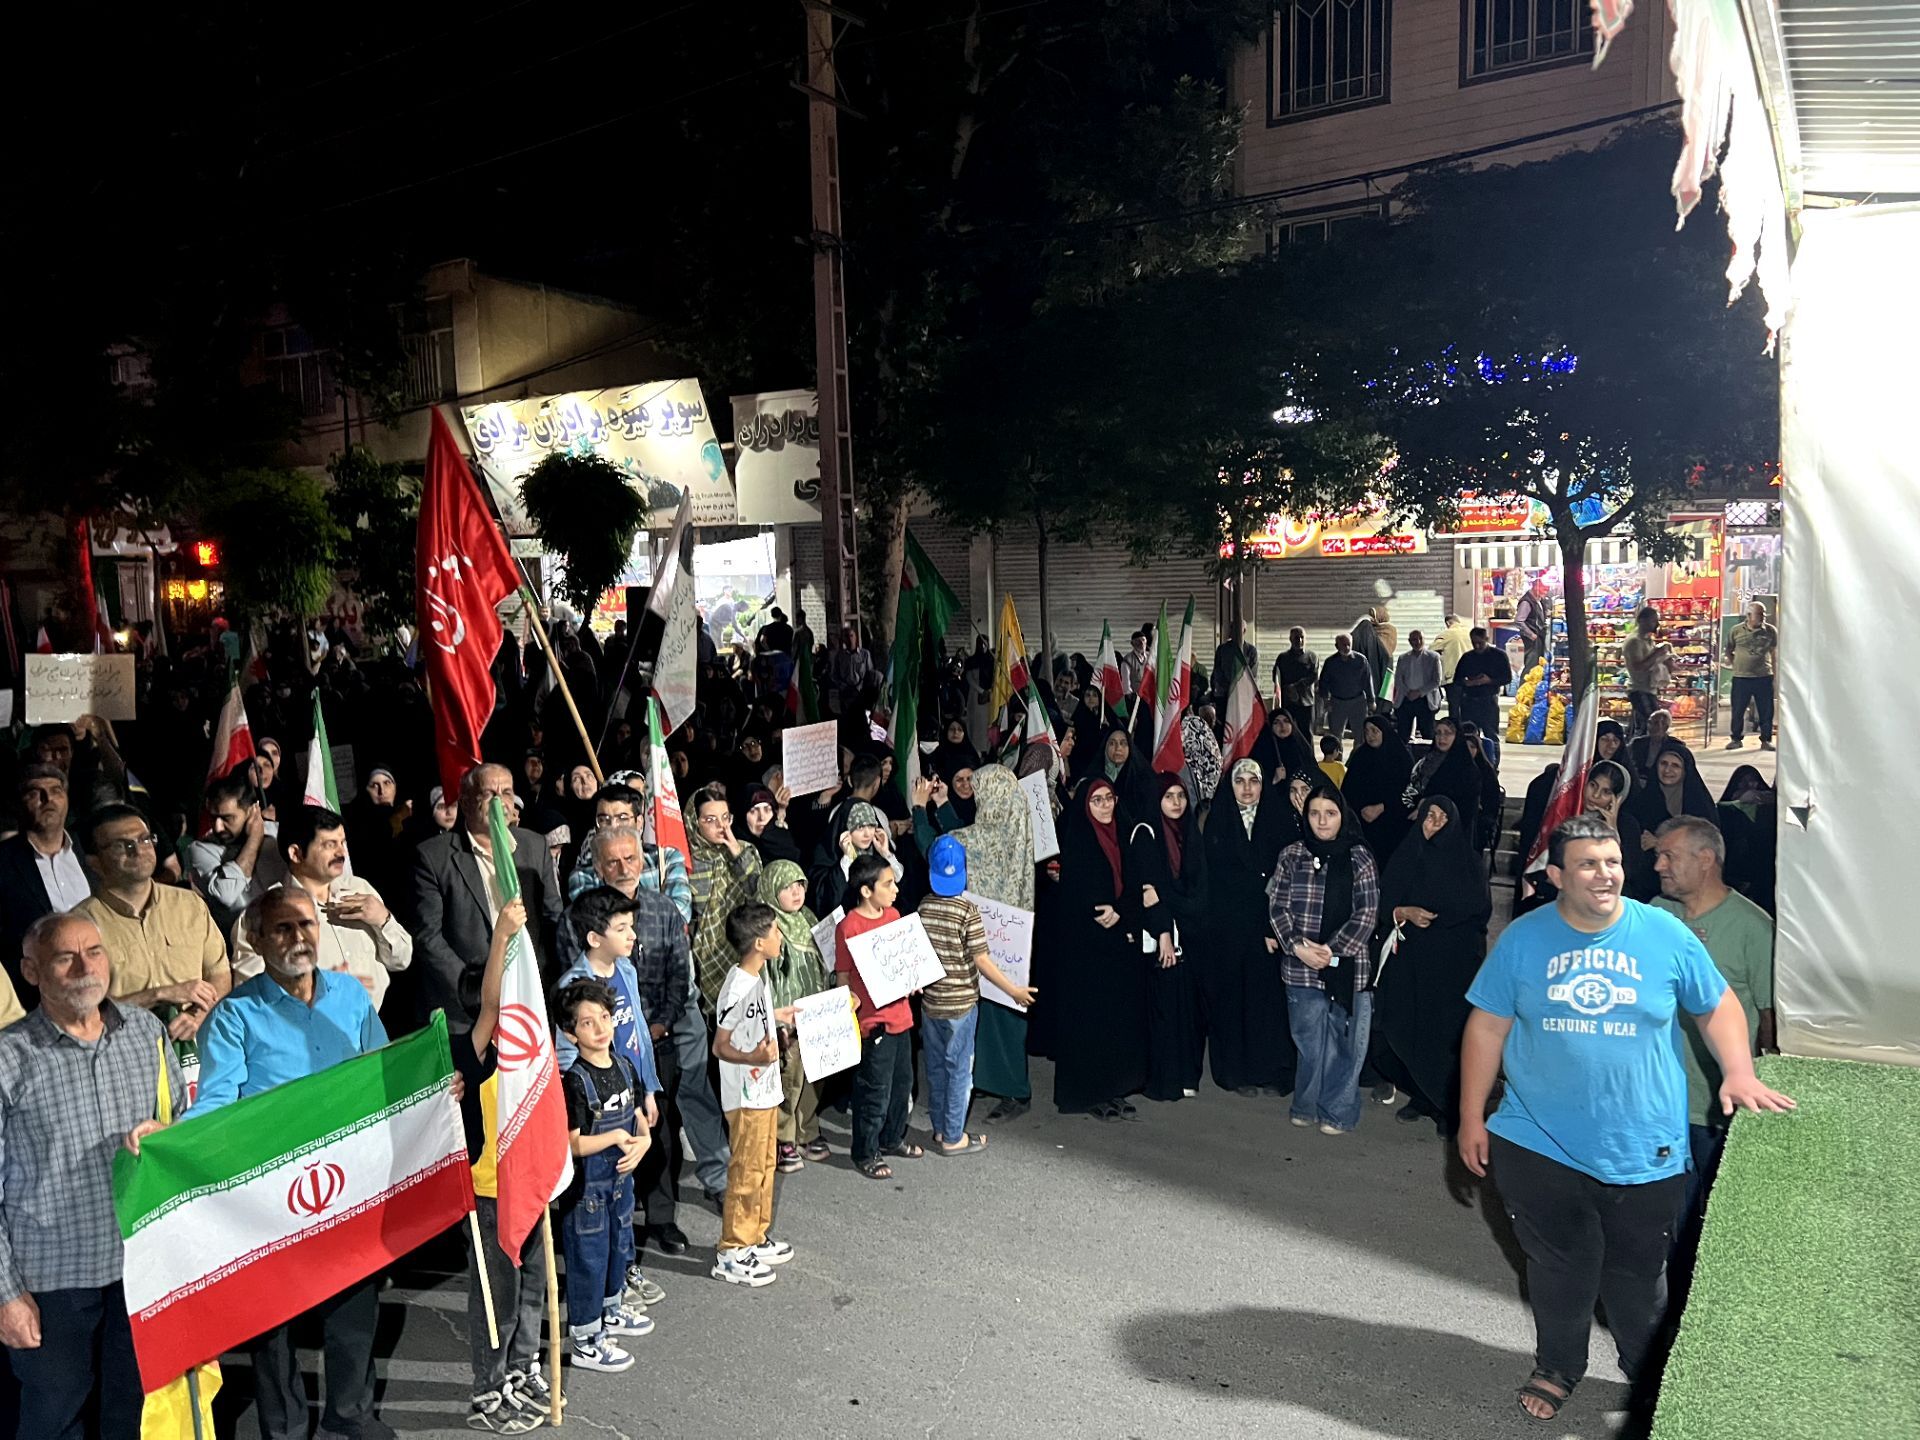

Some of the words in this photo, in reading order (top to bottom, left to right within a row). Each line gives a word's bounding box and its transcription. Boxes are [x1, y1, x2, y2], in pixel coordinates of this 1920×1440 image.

[472, 408, 531, 453] مرادی
[532, 402, 608, 449] برادران
[606, 402, 650, 440] میوه
[659, 399, 707, 437] سوپر
[738, 409, 805, 448] برادران
[1546, 948, 1643, 982] OFFICIAL
[1549, 985, 1565, 998] 19
[1616, 989, 1634, 1002] 62
[1542, 1017, 1598, 1035] GENUINE
[1602, 1020, 1637, 1037] WEAR
